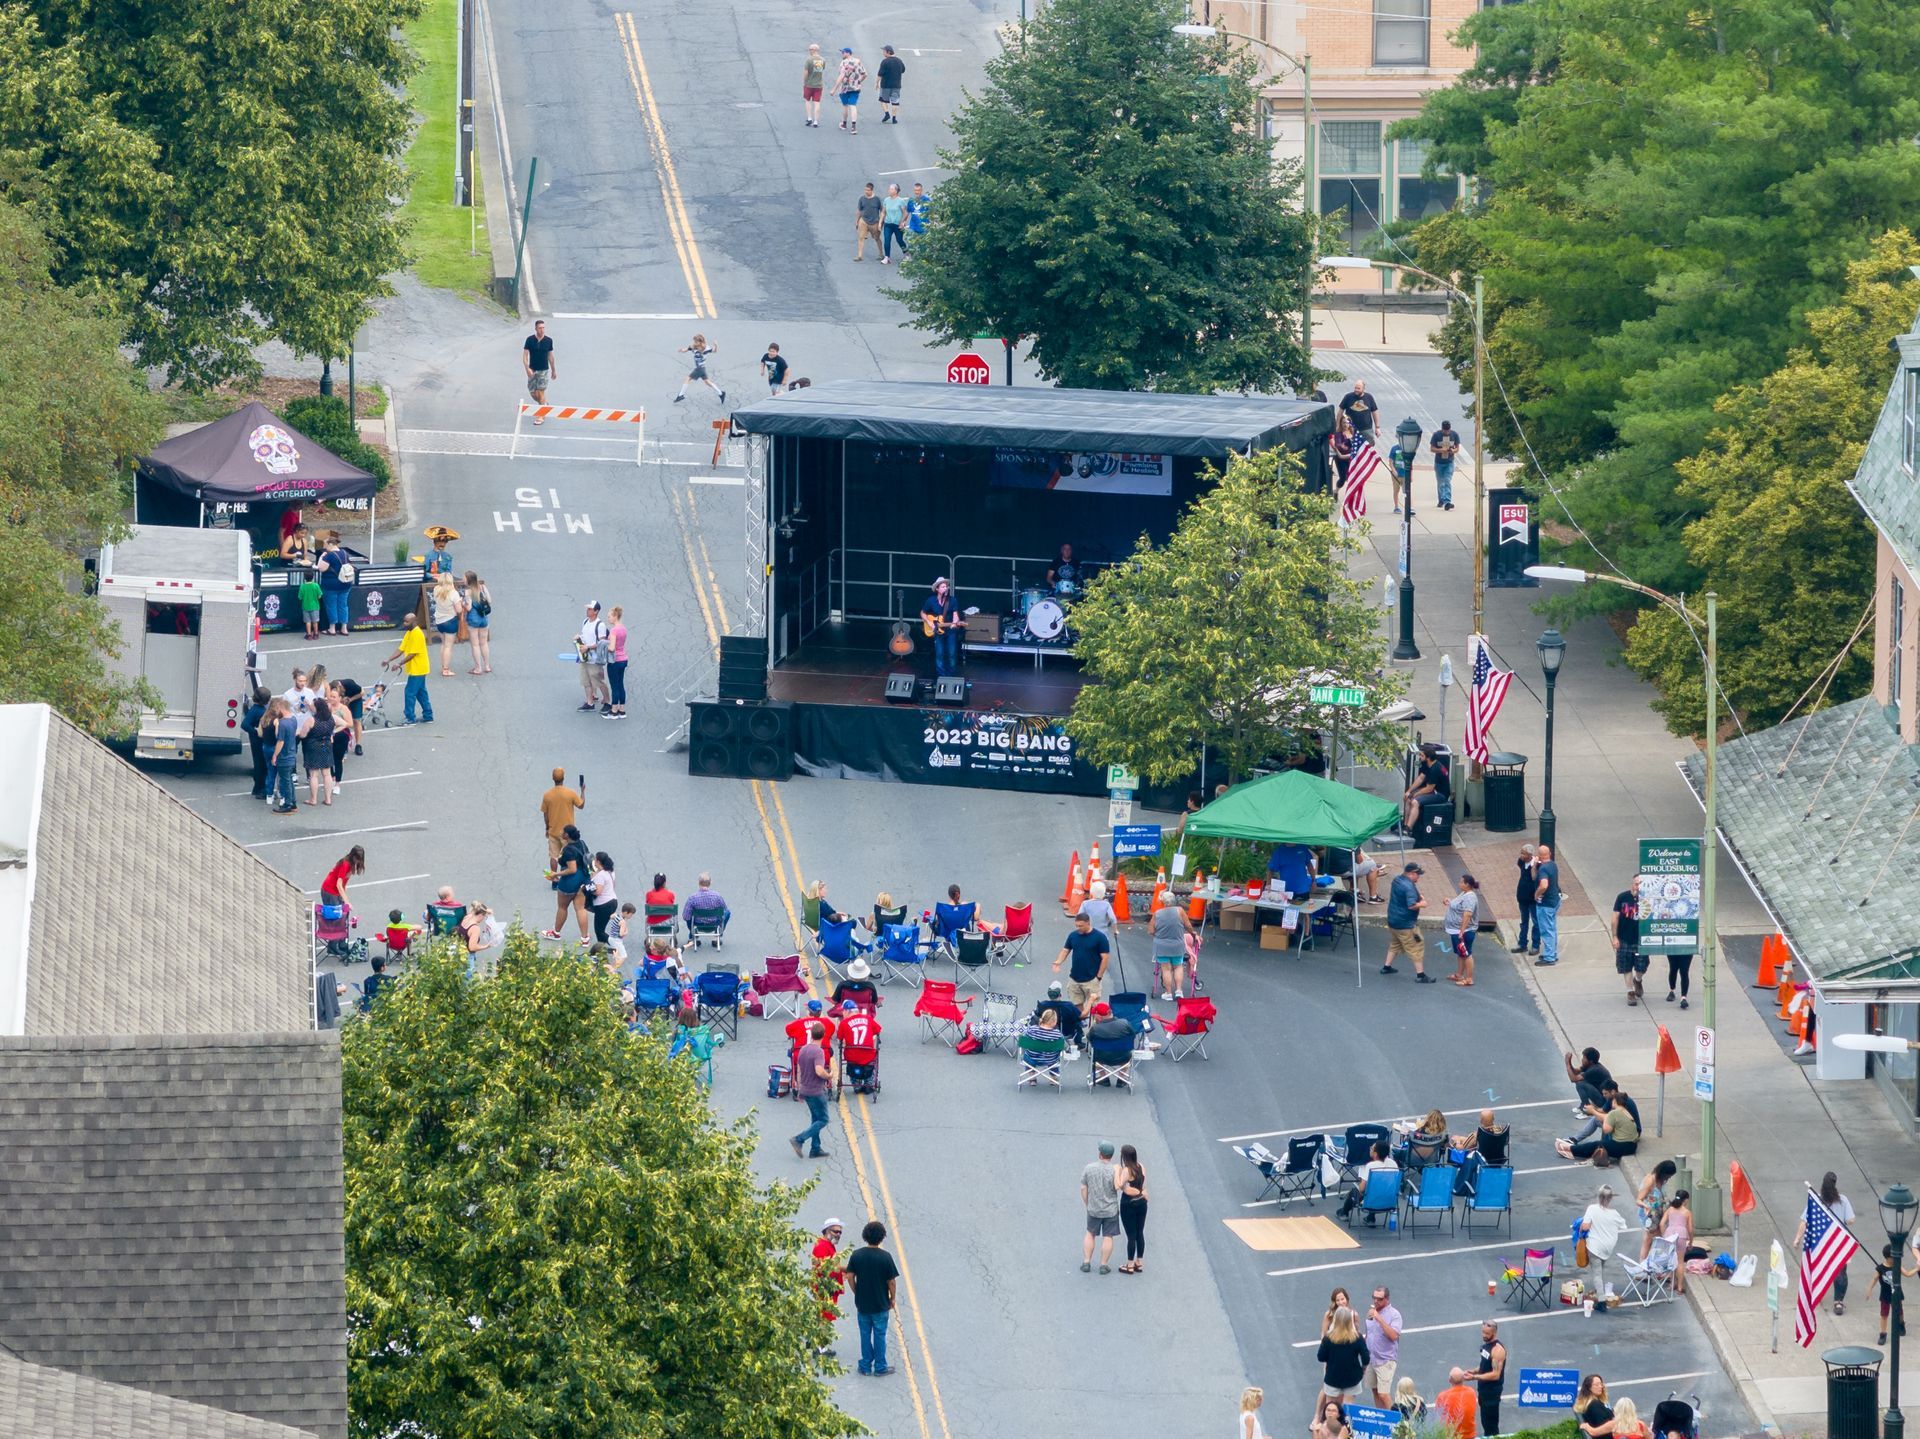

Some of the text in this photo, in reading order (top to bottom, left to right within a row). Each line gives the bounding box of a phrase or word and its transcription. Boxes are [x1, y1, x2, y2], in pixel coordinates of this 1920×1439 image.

[949, 366, 988, 384] STOP
[255, 479, 325, 493] ROGUE TACOS
[273, 489, 317, 499] CATERING
[515, 487, 561, 509] 15
[1503, 509, 1524, 518] ESU
[492, 511, 594, 534] MPH
[1309, 688, 1366, 705] BANK ALLEY
[923, 728, 1071, 750] 2023 BIG BANG
[1648, 848, 1682, 858] Welcome
[1641, 864, 1698, 873] STROUDSBURG
[852, 1026, 867, 1045] 17
